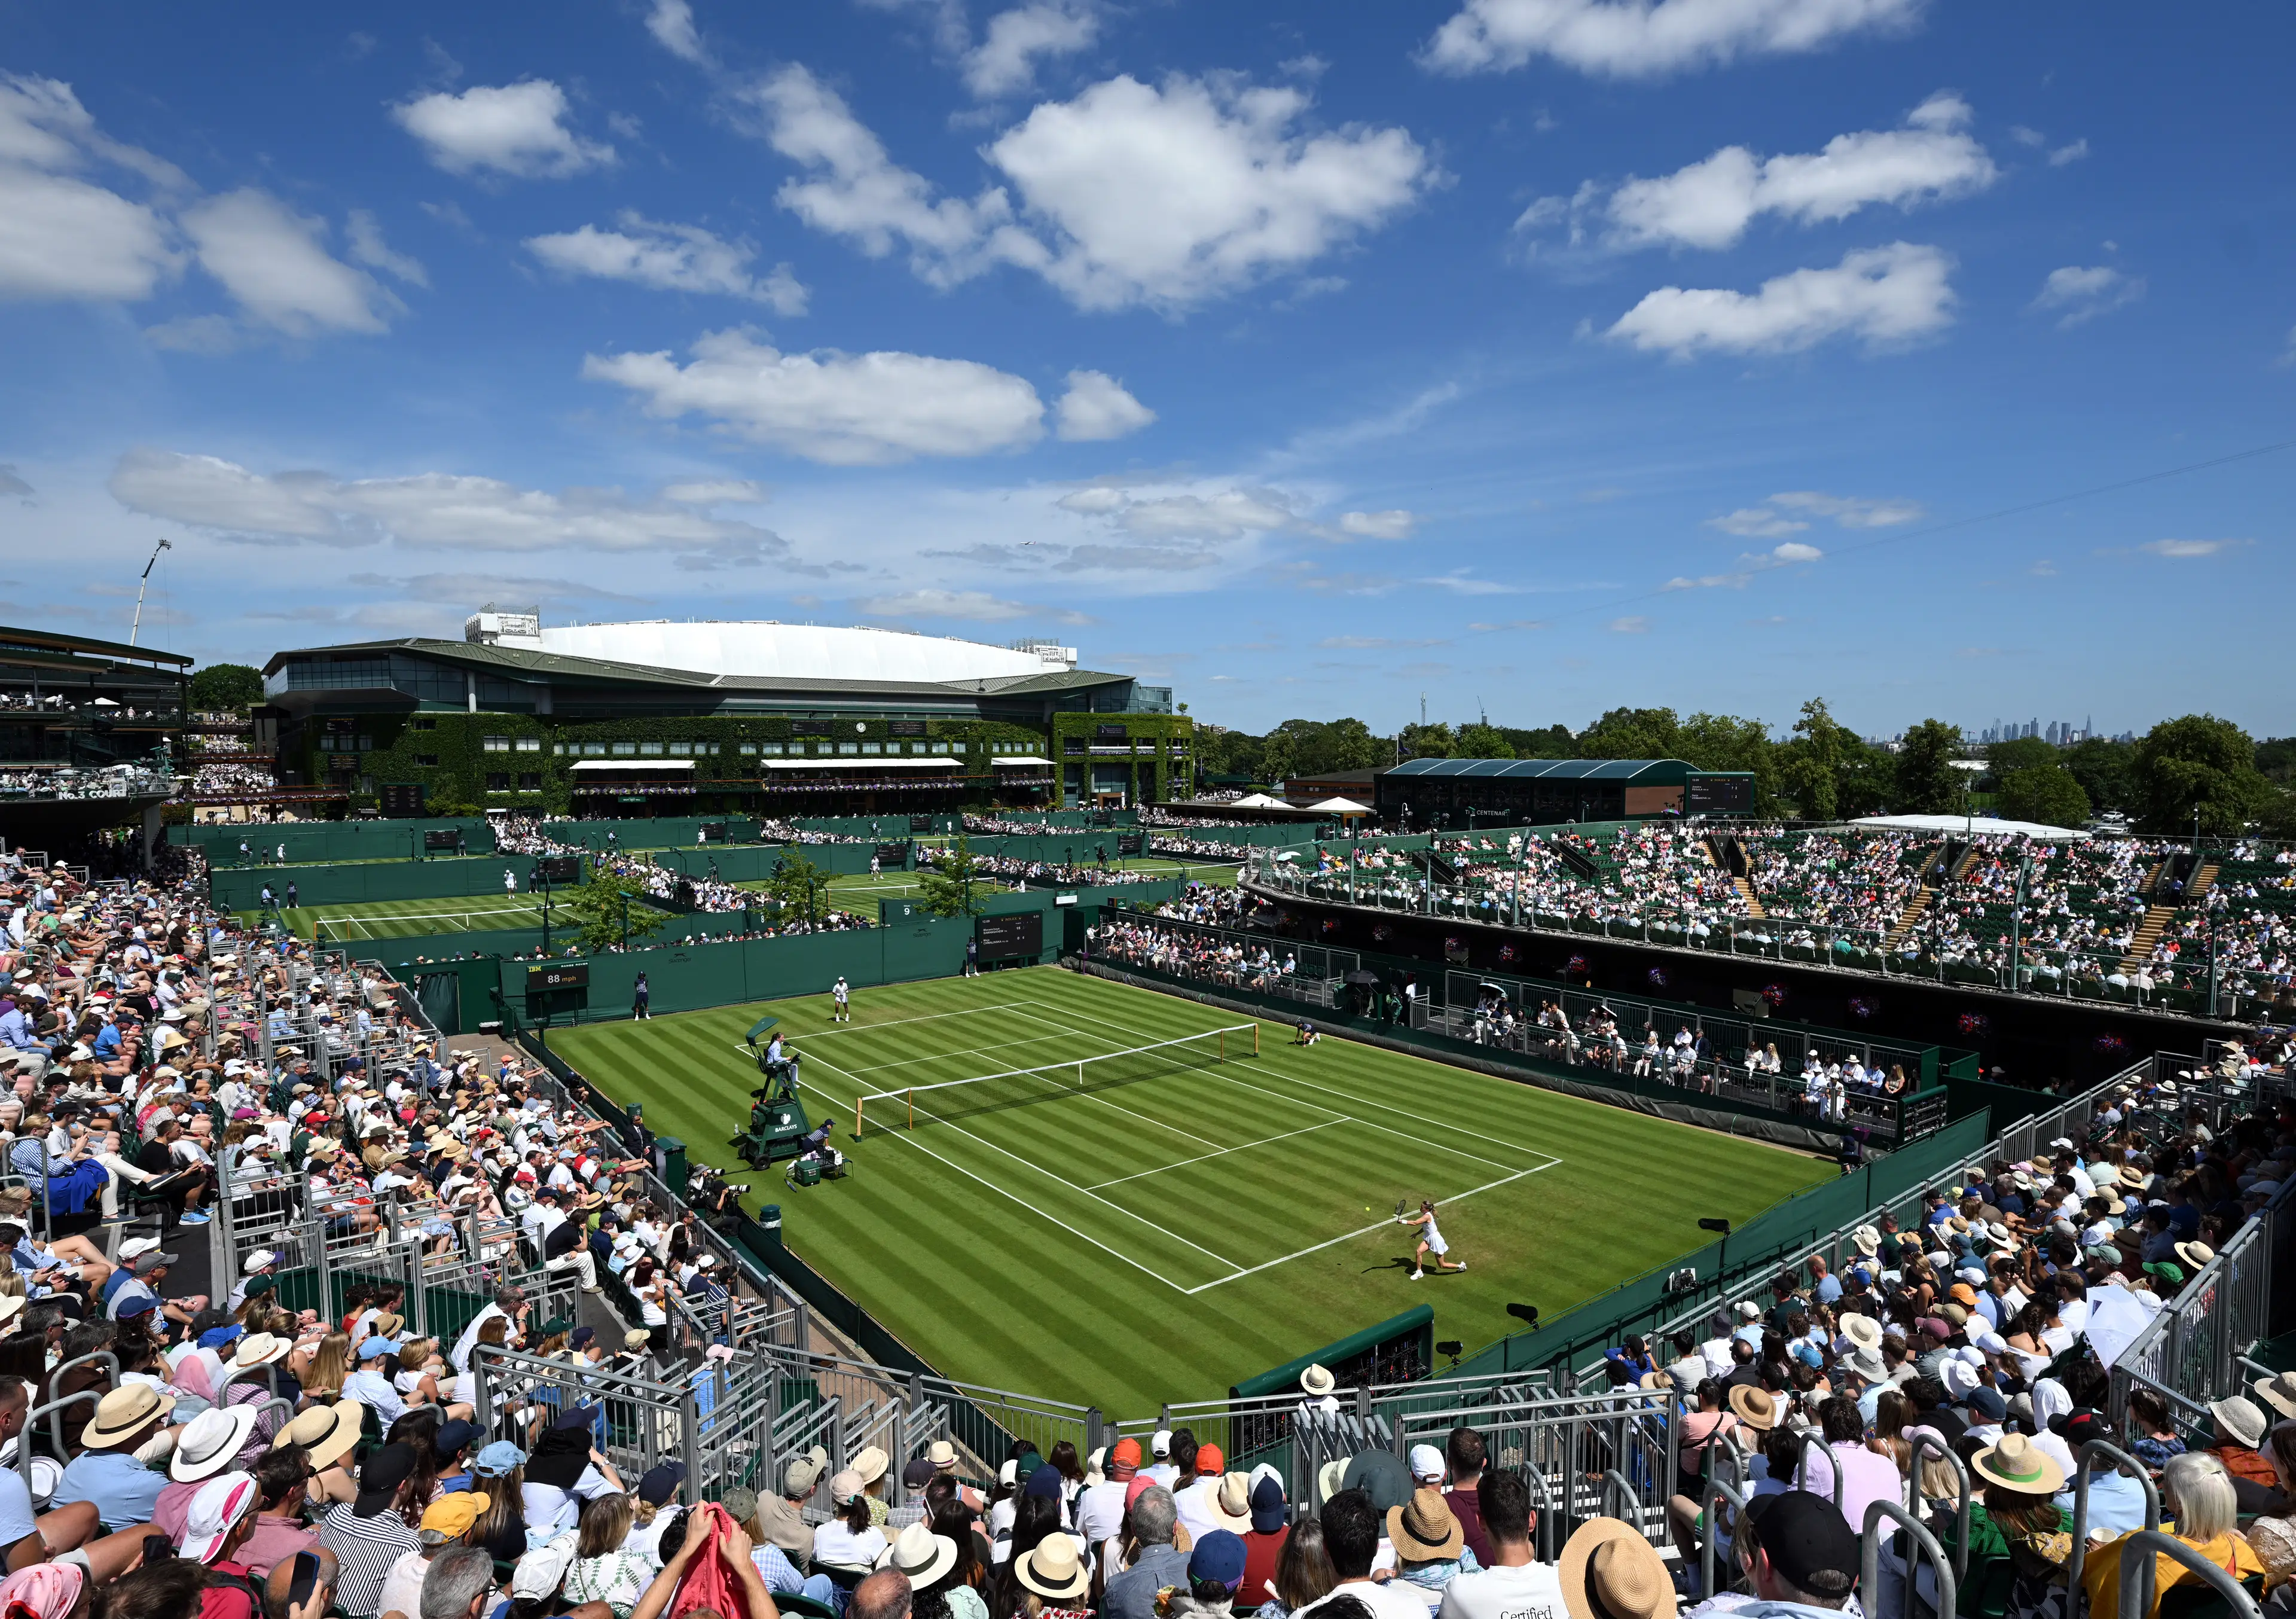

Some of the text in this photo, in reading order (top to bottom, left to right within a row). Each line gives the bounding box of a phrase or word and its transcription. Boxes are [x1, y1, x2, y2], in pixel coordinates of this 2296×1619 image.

[59, 791, 86, 800] No.3
[904, 907, 910, 916] 9
[548, 974, 560, 983] 88
[775, 1124, 798, 1133] BARCLAYS
[1500, 1605, 1553, 1619] Certified
